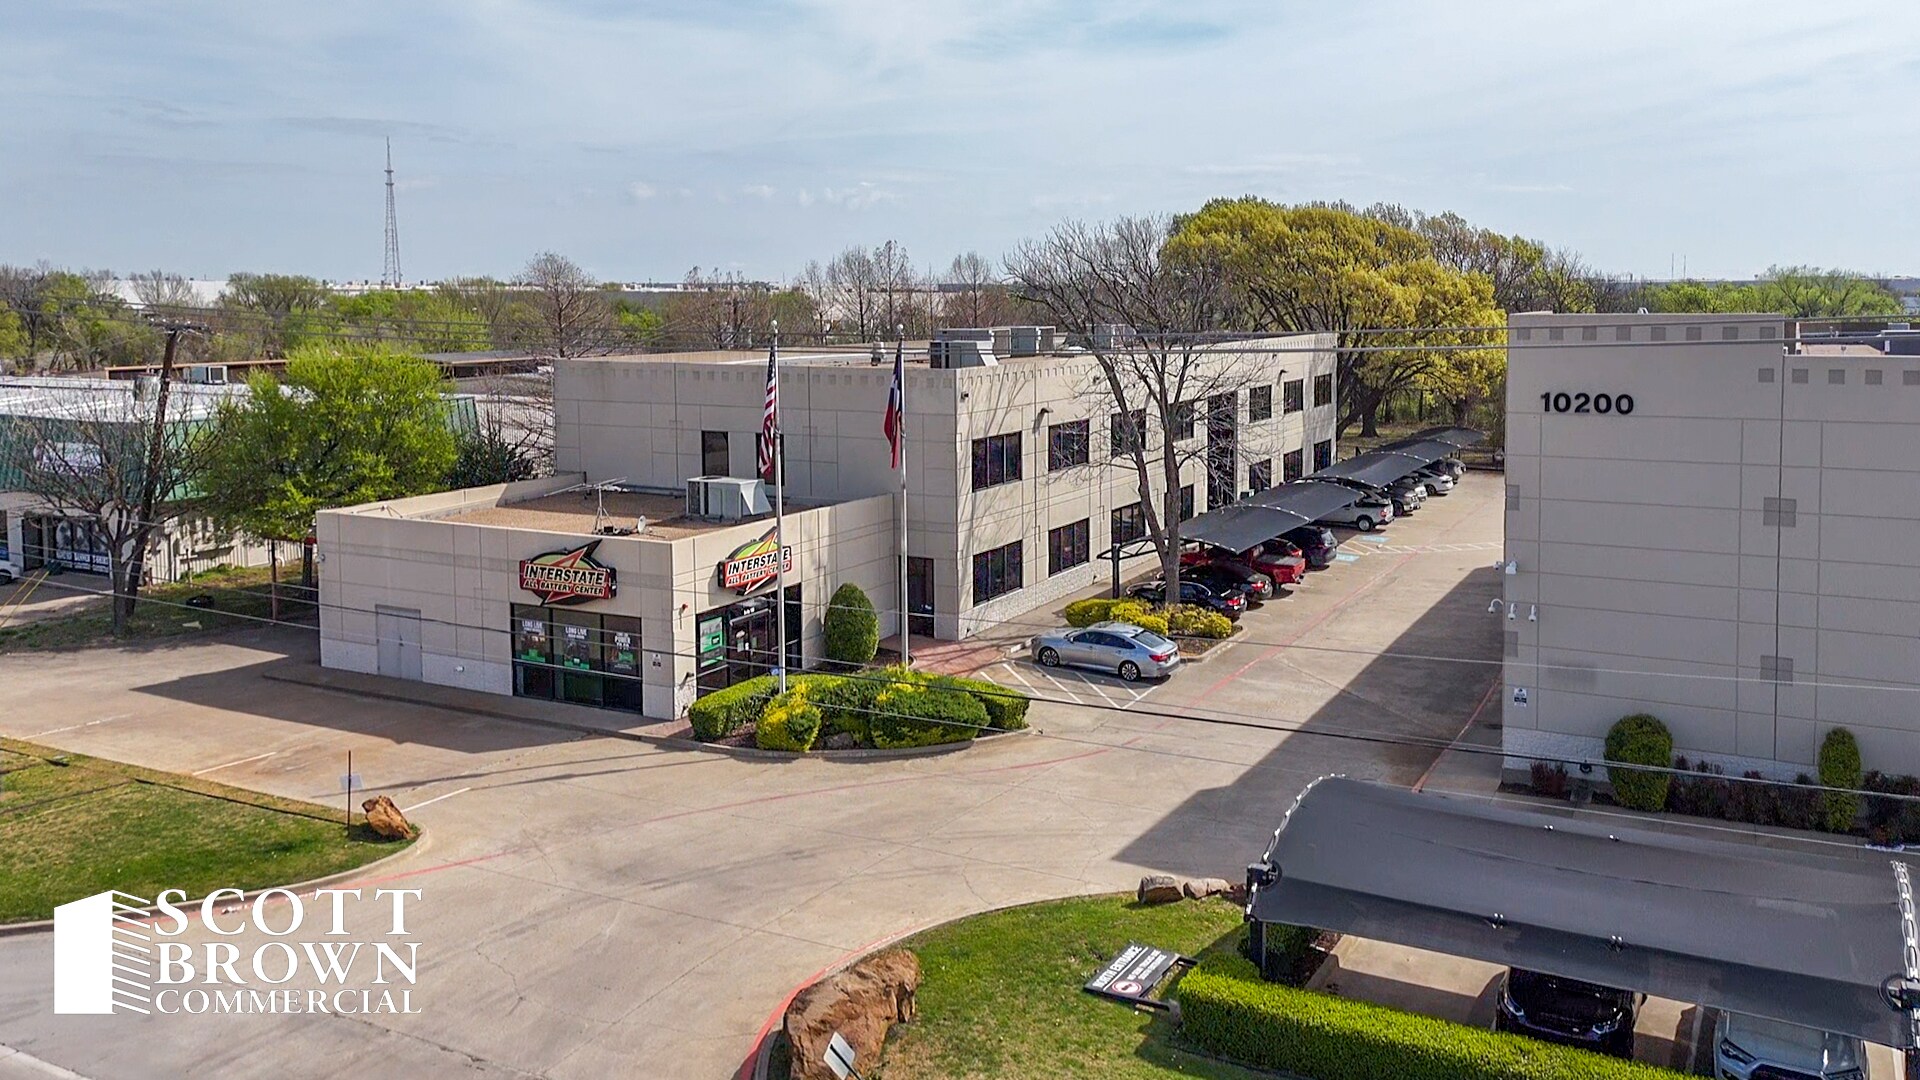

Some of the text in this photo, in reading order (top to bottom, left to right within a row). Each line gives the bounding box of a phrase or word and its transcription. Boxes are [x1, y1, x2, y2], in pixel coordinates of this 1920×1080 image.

[1541, 392, 1634, 415] 10200
[728, 549, 789, 575] INTERSTAE
[525, 565, 605, 586] INTERSTATE
[524, 580, 604, 596] ALL BATTERY CENTER
